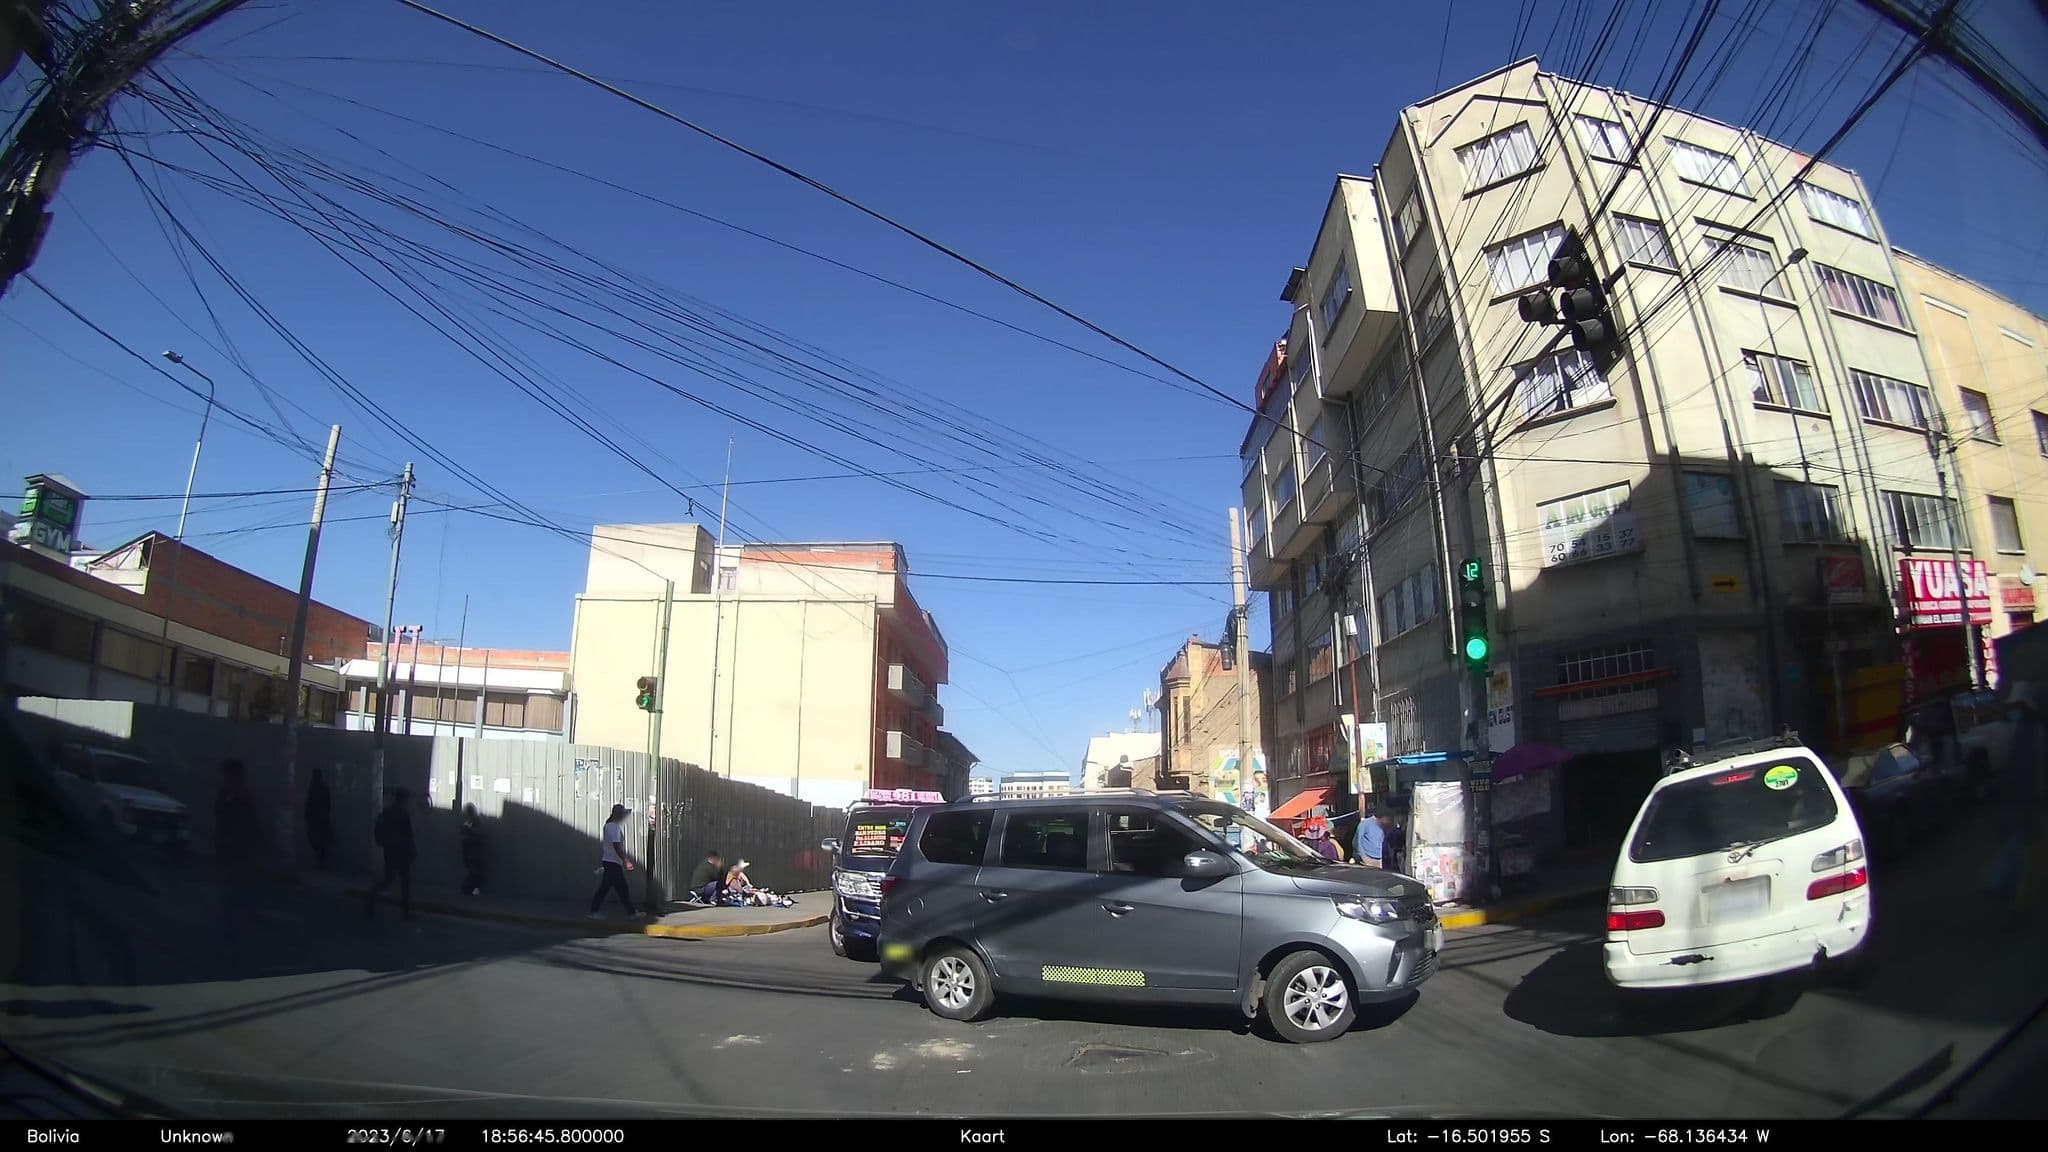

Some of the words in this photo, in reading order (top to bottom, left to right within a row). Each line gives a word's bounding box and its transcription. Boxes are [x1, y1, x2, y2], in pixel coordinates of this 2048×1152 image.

[34, 522, 71, 551] GYM
[1550, 543, 1564, 553] 70
[1598, 533, 1611, 542] 15
[1619, 527, 1634, 539] 37
[1466, 563, 1478, 578] 12
[1908, 561, 1988, 599] YUASA
